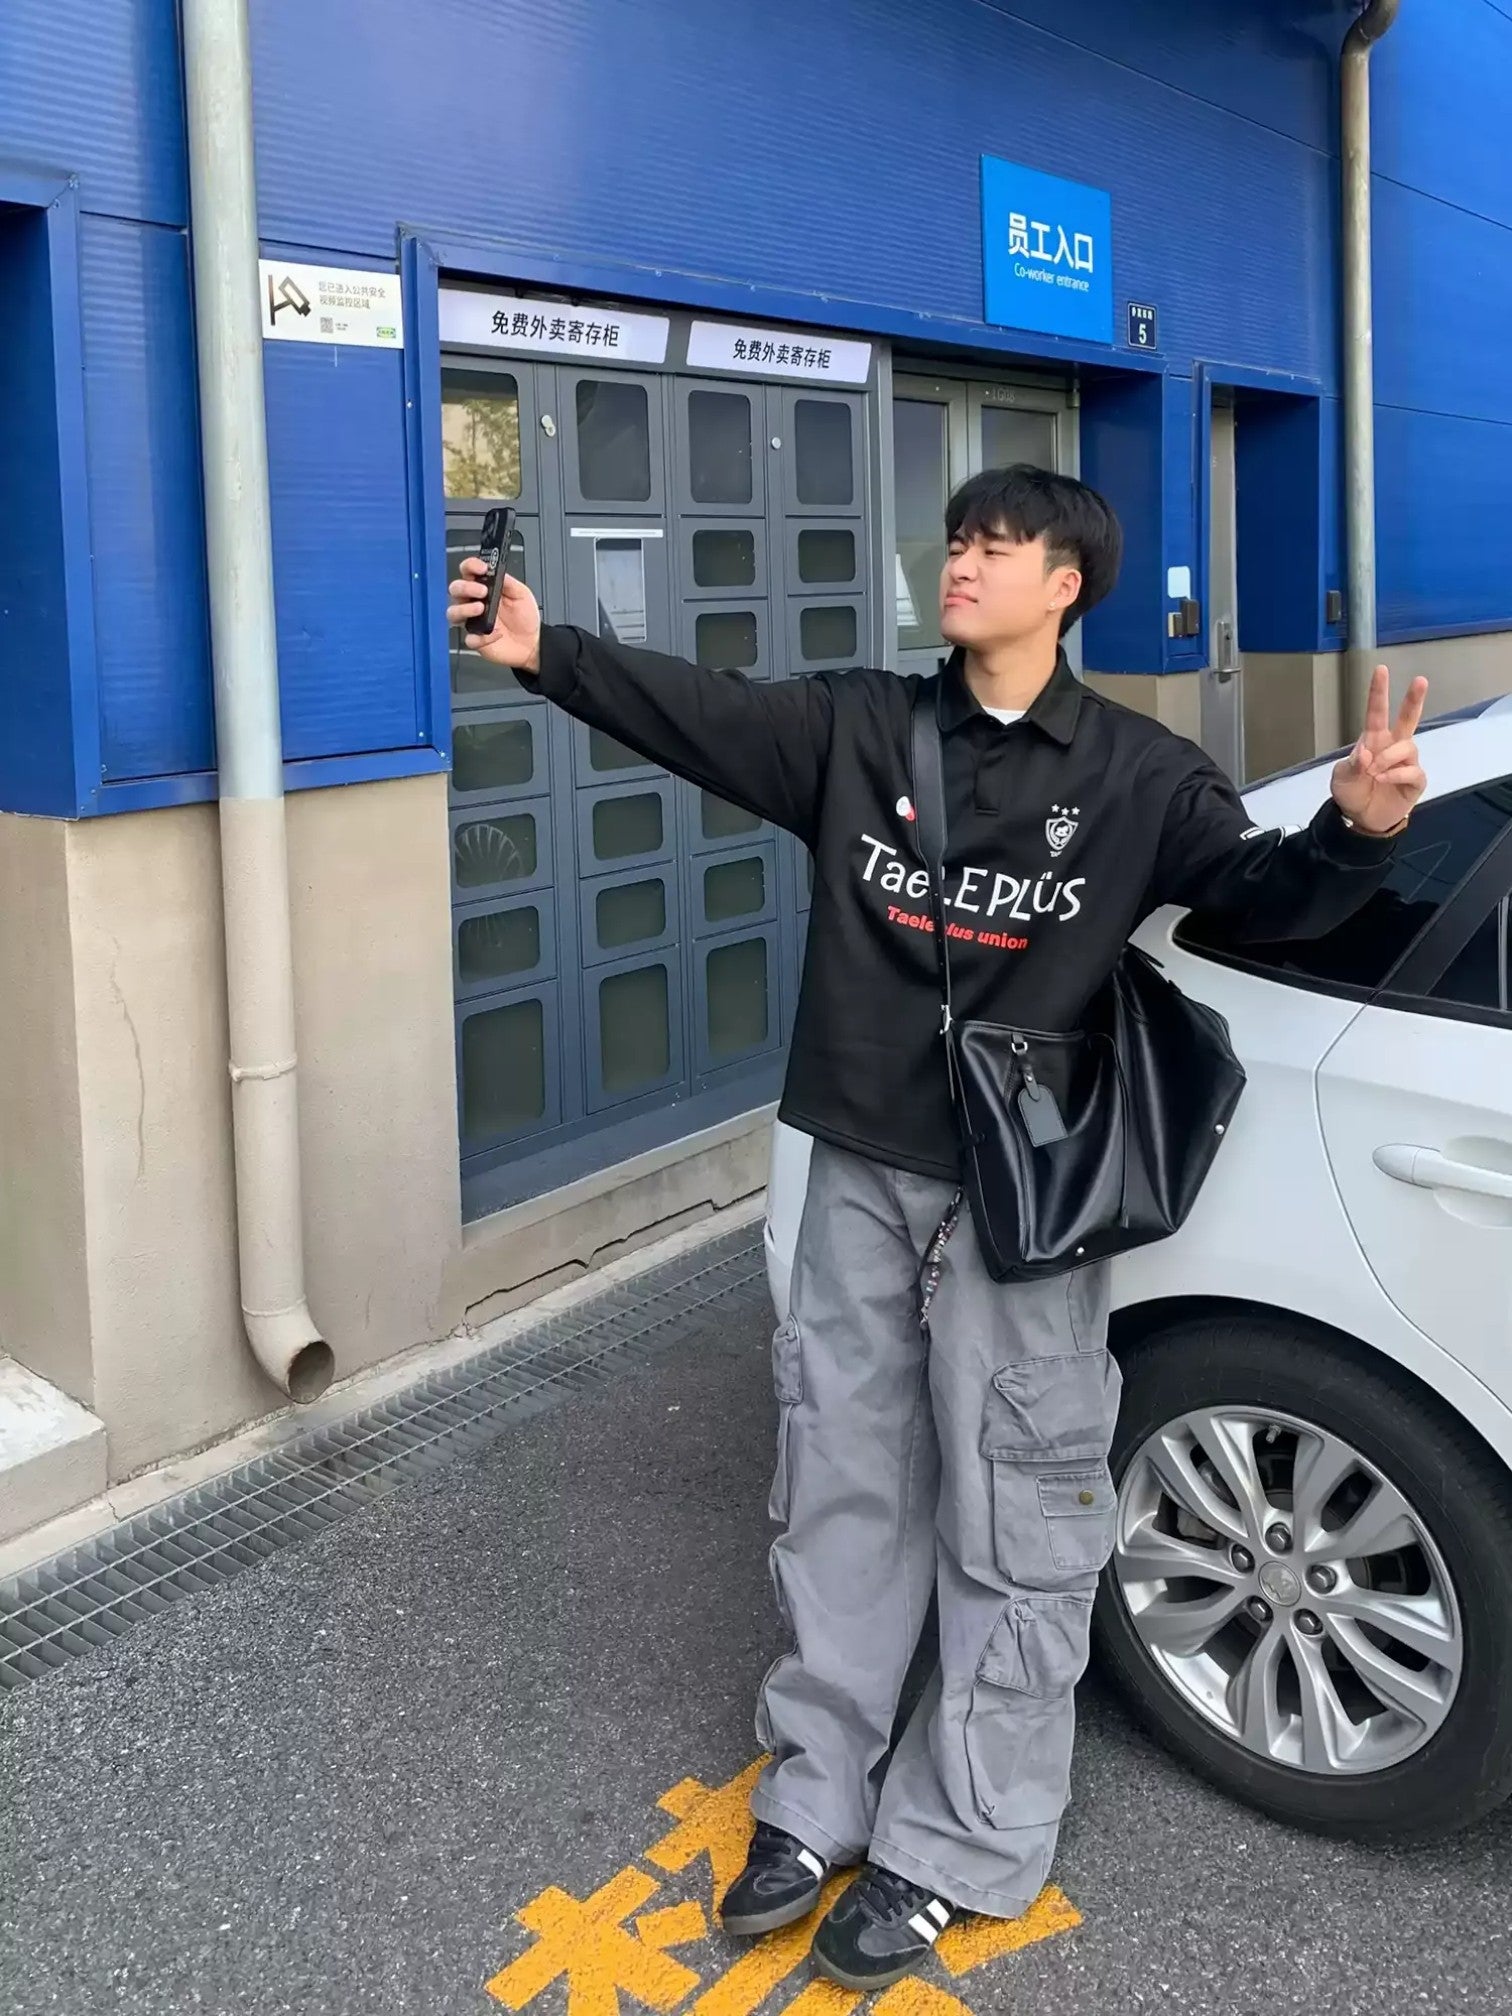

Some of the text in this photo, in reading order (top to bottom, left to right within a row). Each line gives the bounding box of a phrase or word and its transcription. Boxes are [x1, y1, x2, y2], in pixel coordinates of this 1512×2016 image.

[1008, 211, 1093, 273] 员工入口
[1014, 262, 1090, 292] Co-worker entrance
[491, 310, 620, 347] 免费外卖寄存柜
[1138, 323, 1147, 344] 5
[733, 338, 832, 369] 免费外卖寄存柜
[887, 905, 1028, 949] Taelelus union
